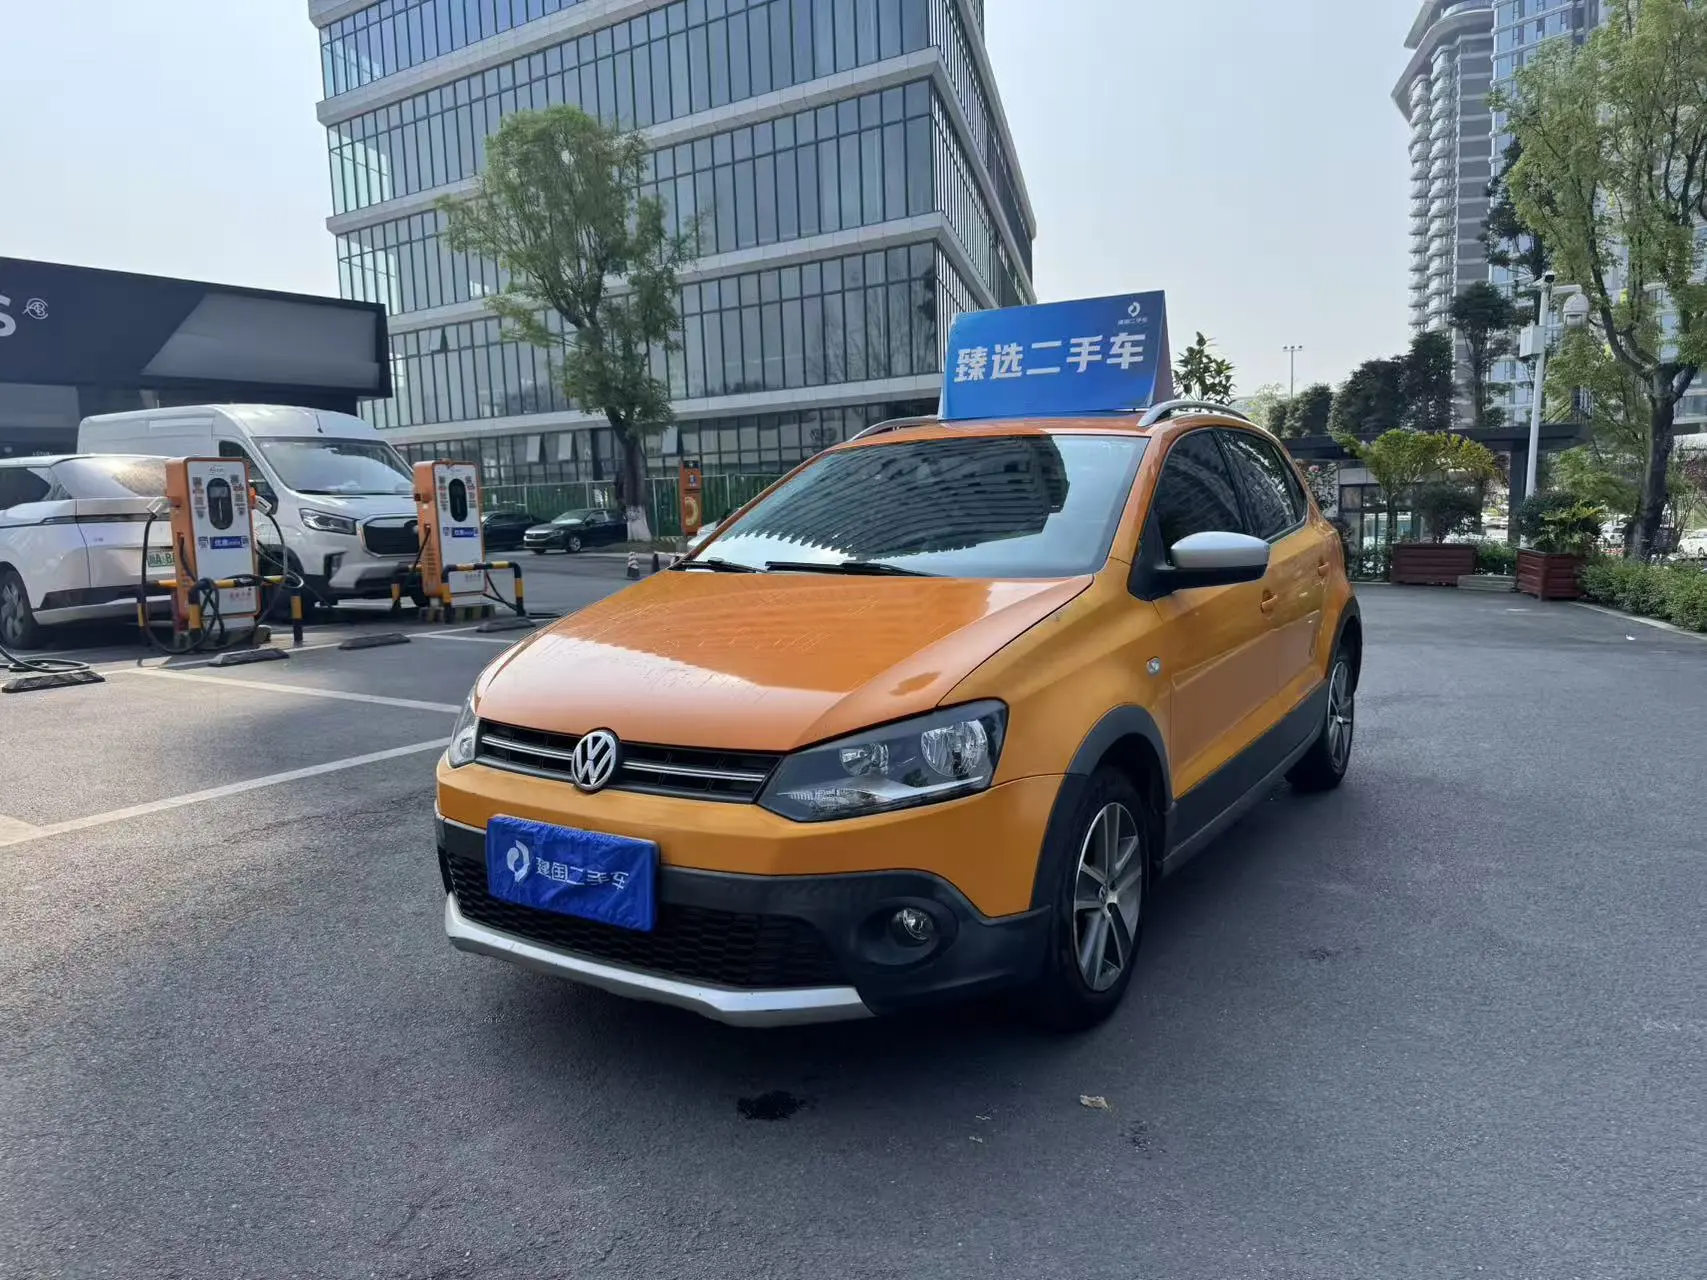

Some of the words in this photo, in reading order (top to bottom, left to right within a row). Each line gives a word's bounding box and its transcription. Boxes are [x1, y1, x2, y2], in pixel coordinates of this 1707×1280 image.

[954, 332, 1146, 383] 臻选二手车
[536, 857, 629, 889] 建国二手车
